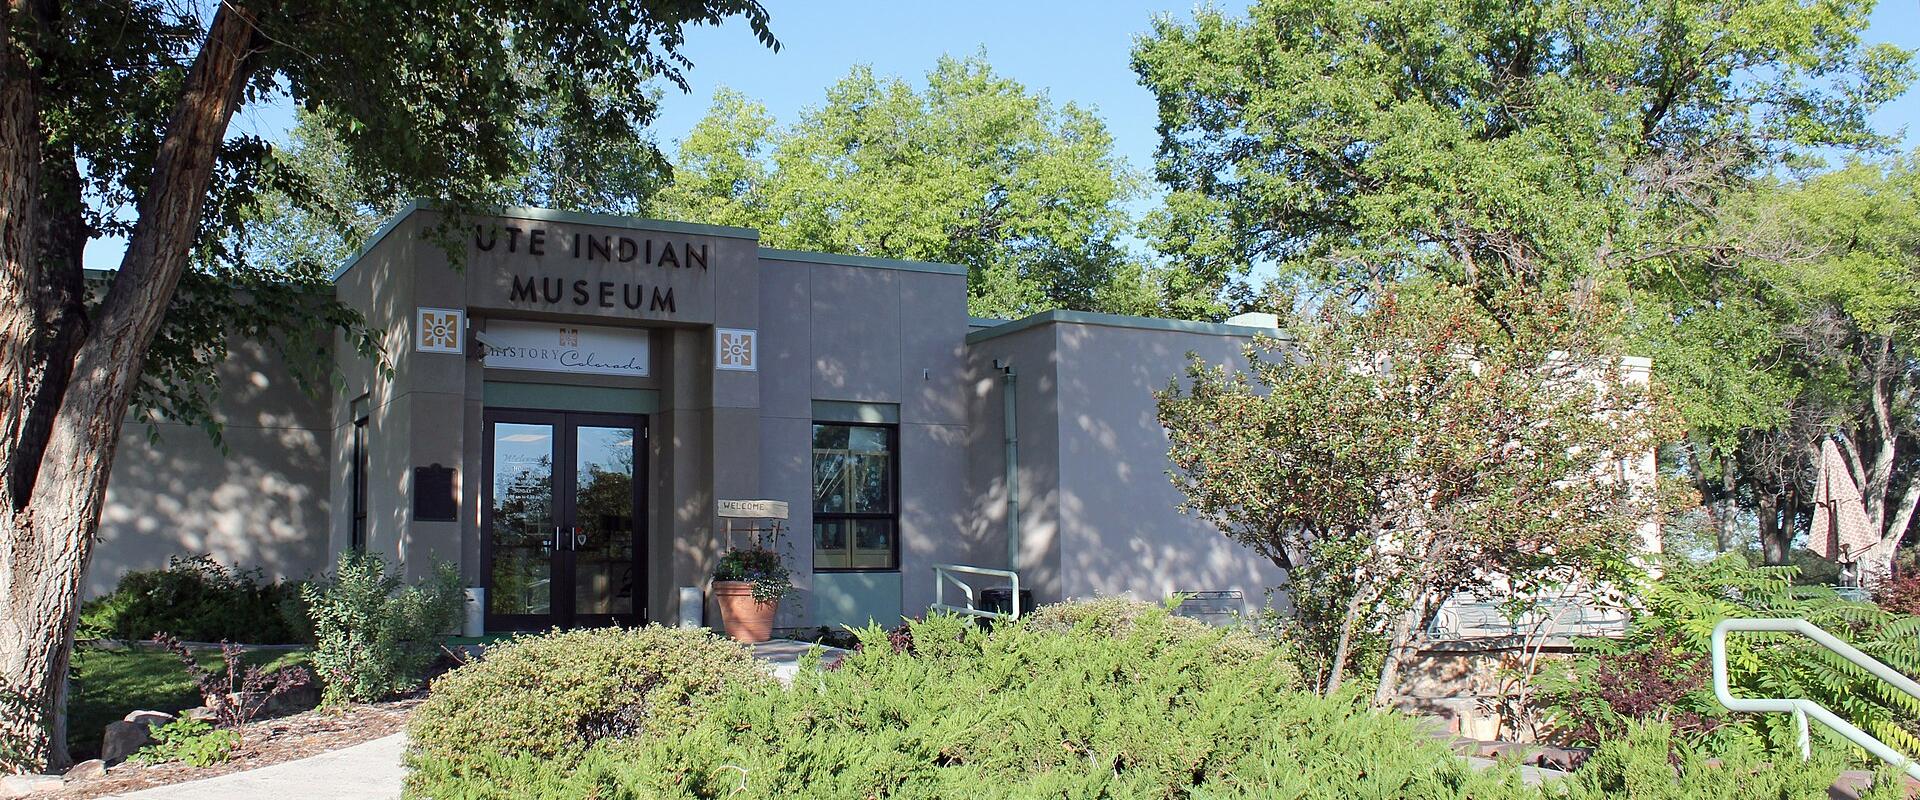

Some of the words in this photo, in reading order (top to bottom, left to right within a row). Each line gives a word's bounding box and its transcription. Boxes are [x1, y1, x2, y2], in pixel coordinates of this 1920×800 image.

[475, 224, 546, 256] UTE
[573, 233, 709, 272] INDIAN
[510, 275, 677, 313] MUSEUM
[560, 350, 643, 371] Colorado
[723, 501, 765, 511] WELCOME
